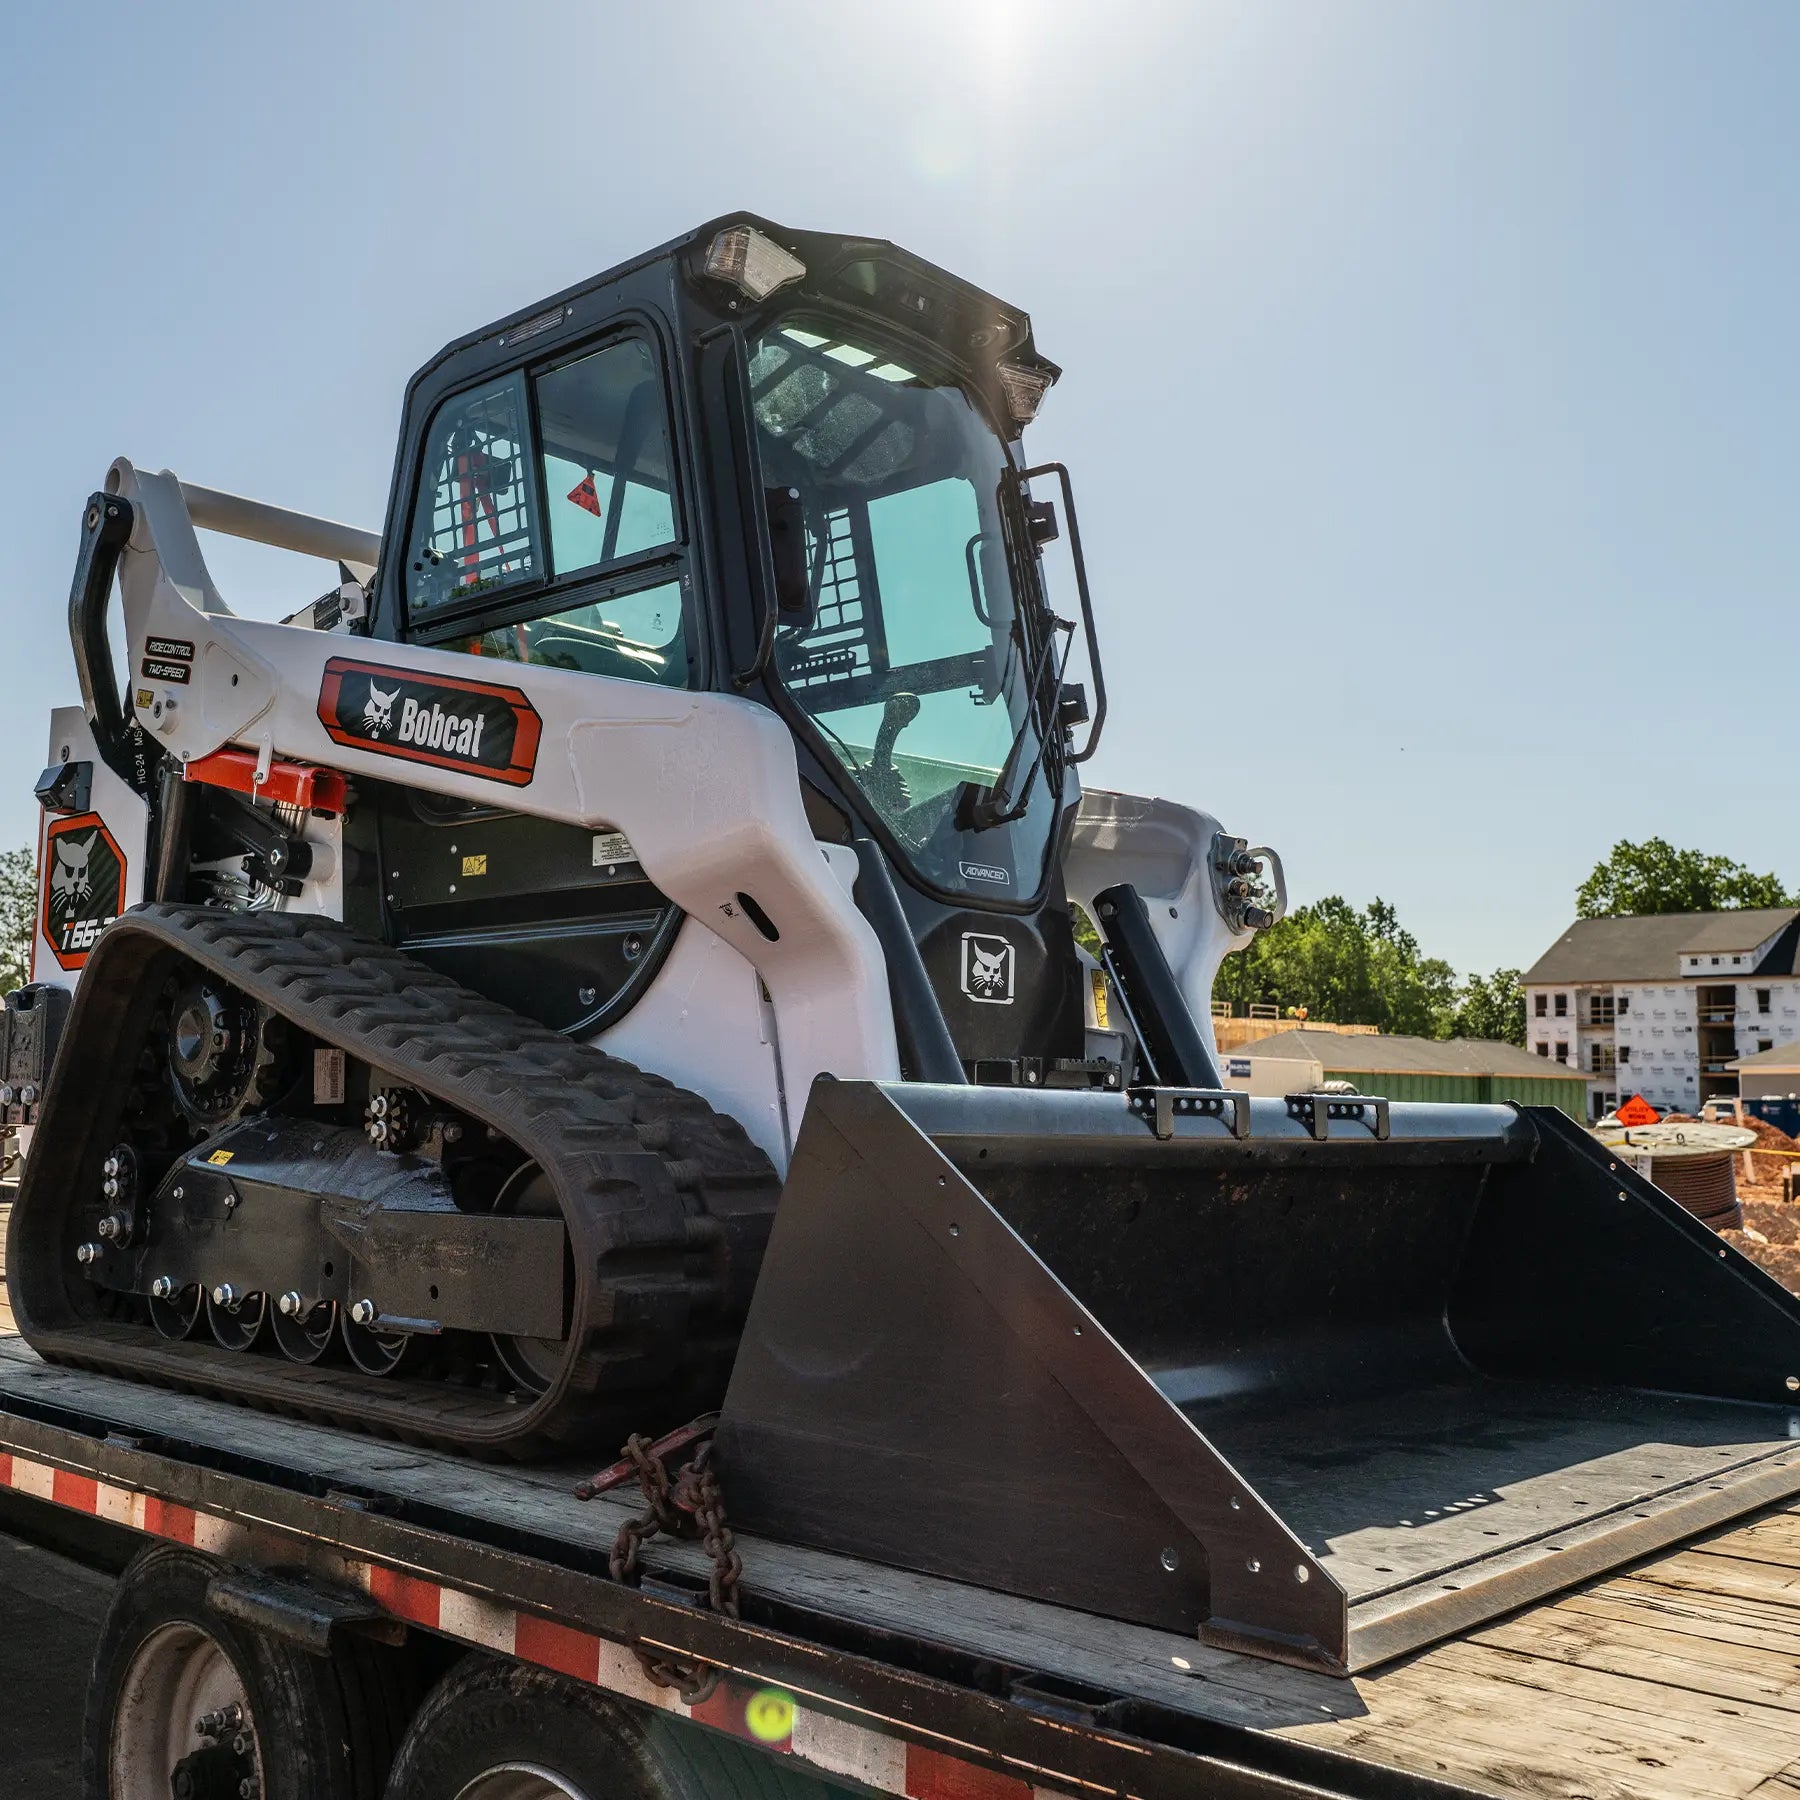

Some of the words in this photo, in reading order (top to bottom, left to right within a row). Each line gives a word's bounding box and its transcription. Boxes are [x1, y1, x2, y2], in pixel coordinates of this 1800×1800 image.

[149, 663, 186, 679] TWO-SPEED
[398, 697, 485, 758] Bobcat
[135, 753, 146, 785] HG-24
[965, 866, 1005, 880] ADVANCED
[61, 916, 116, 951] T66-
